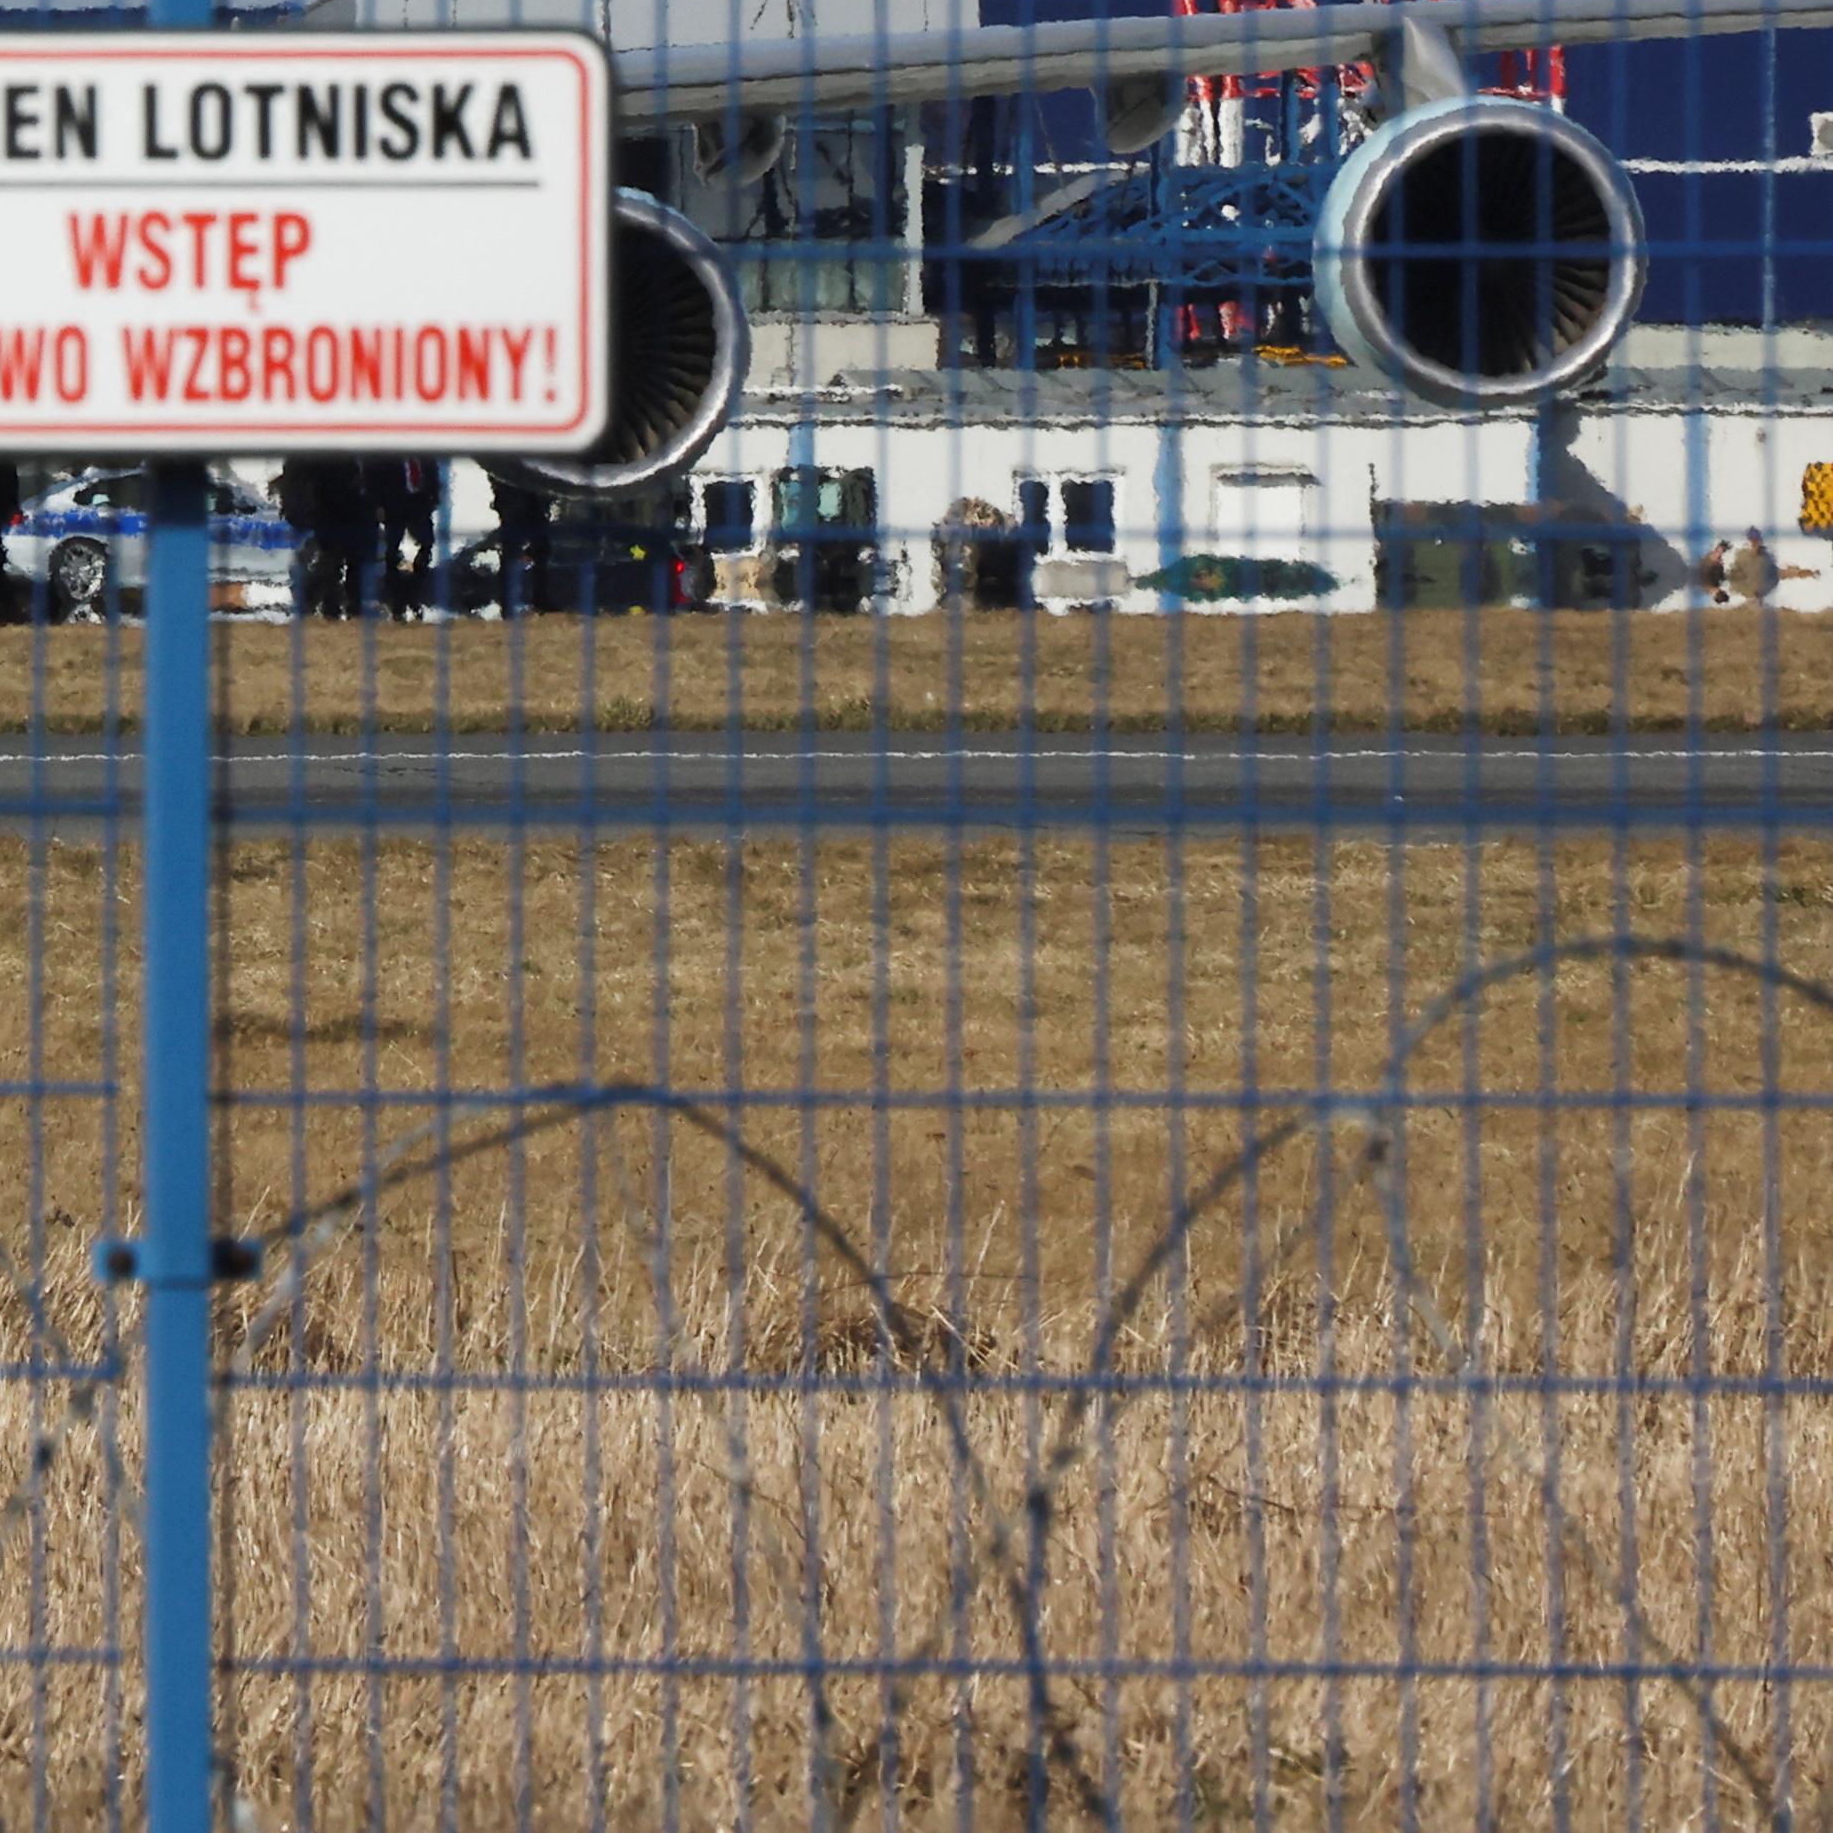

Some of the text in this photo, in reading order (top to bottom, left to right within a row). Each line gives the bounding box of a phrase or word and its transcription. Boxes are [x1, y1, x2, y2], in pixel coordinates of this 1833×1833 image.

[143, 82, 533, 162] LOTNISKA
[69, 211, 312, 311] WSTĘP
[123, 324, 559, 404] WZBRONIONY!
